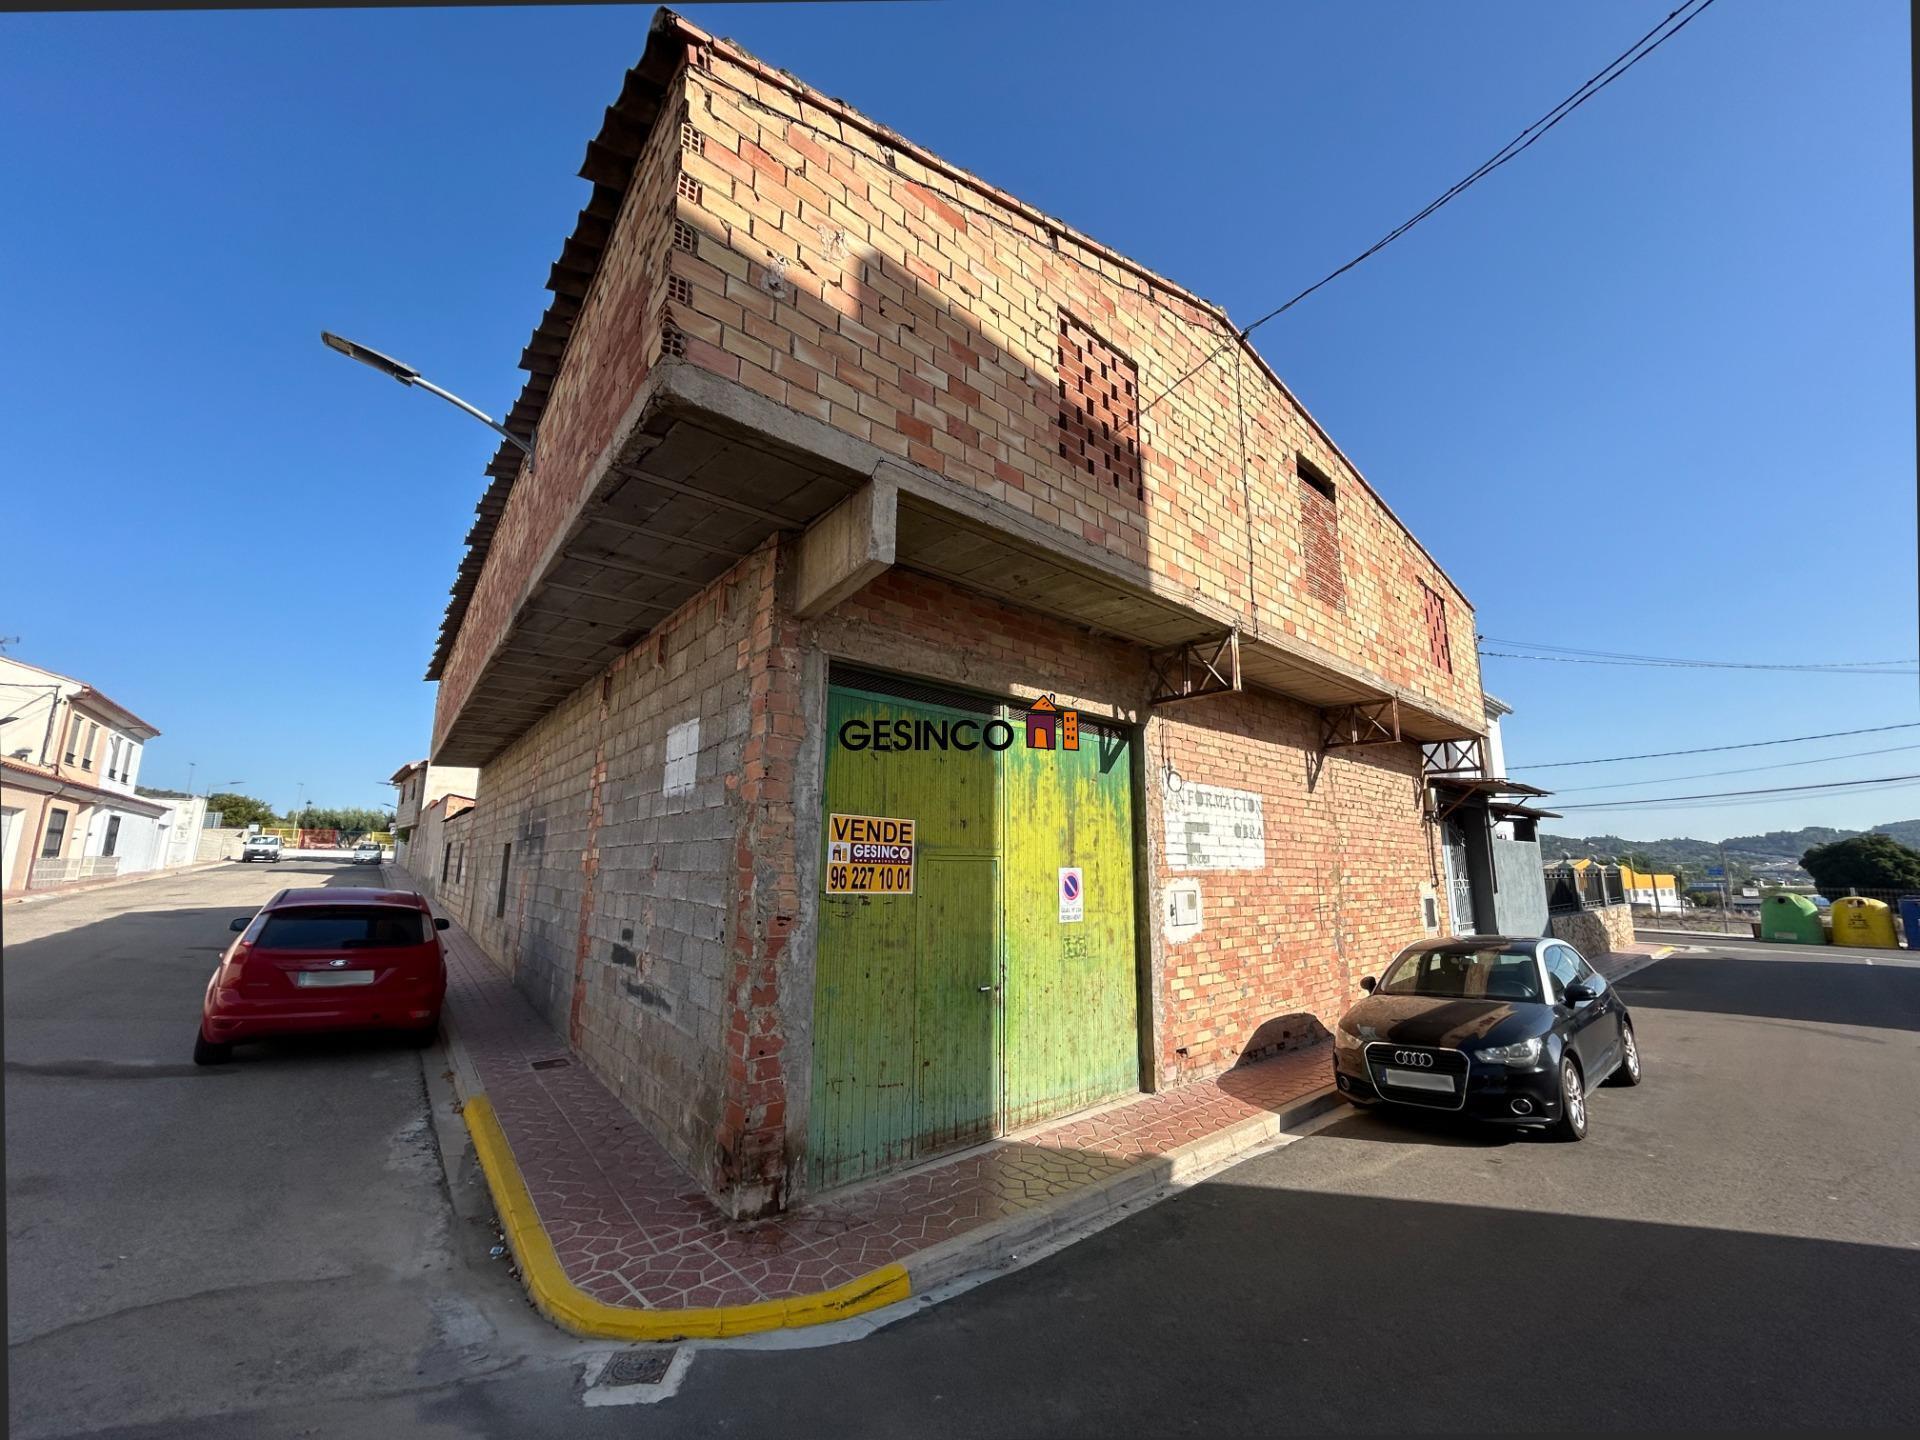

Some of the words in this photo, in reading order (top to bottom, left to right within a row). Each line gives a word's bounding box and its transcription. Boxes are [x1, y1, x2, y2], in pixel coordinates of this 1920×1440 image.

[833, 818, 912, 844] VENDE
[853, 844, 910, 860] GESINCO
[831, 866, 847, 889] 96
[851, 867, 874, 889] 227
[879, 867, 893, 889] 10
[897, 867, 910, 889] 01
